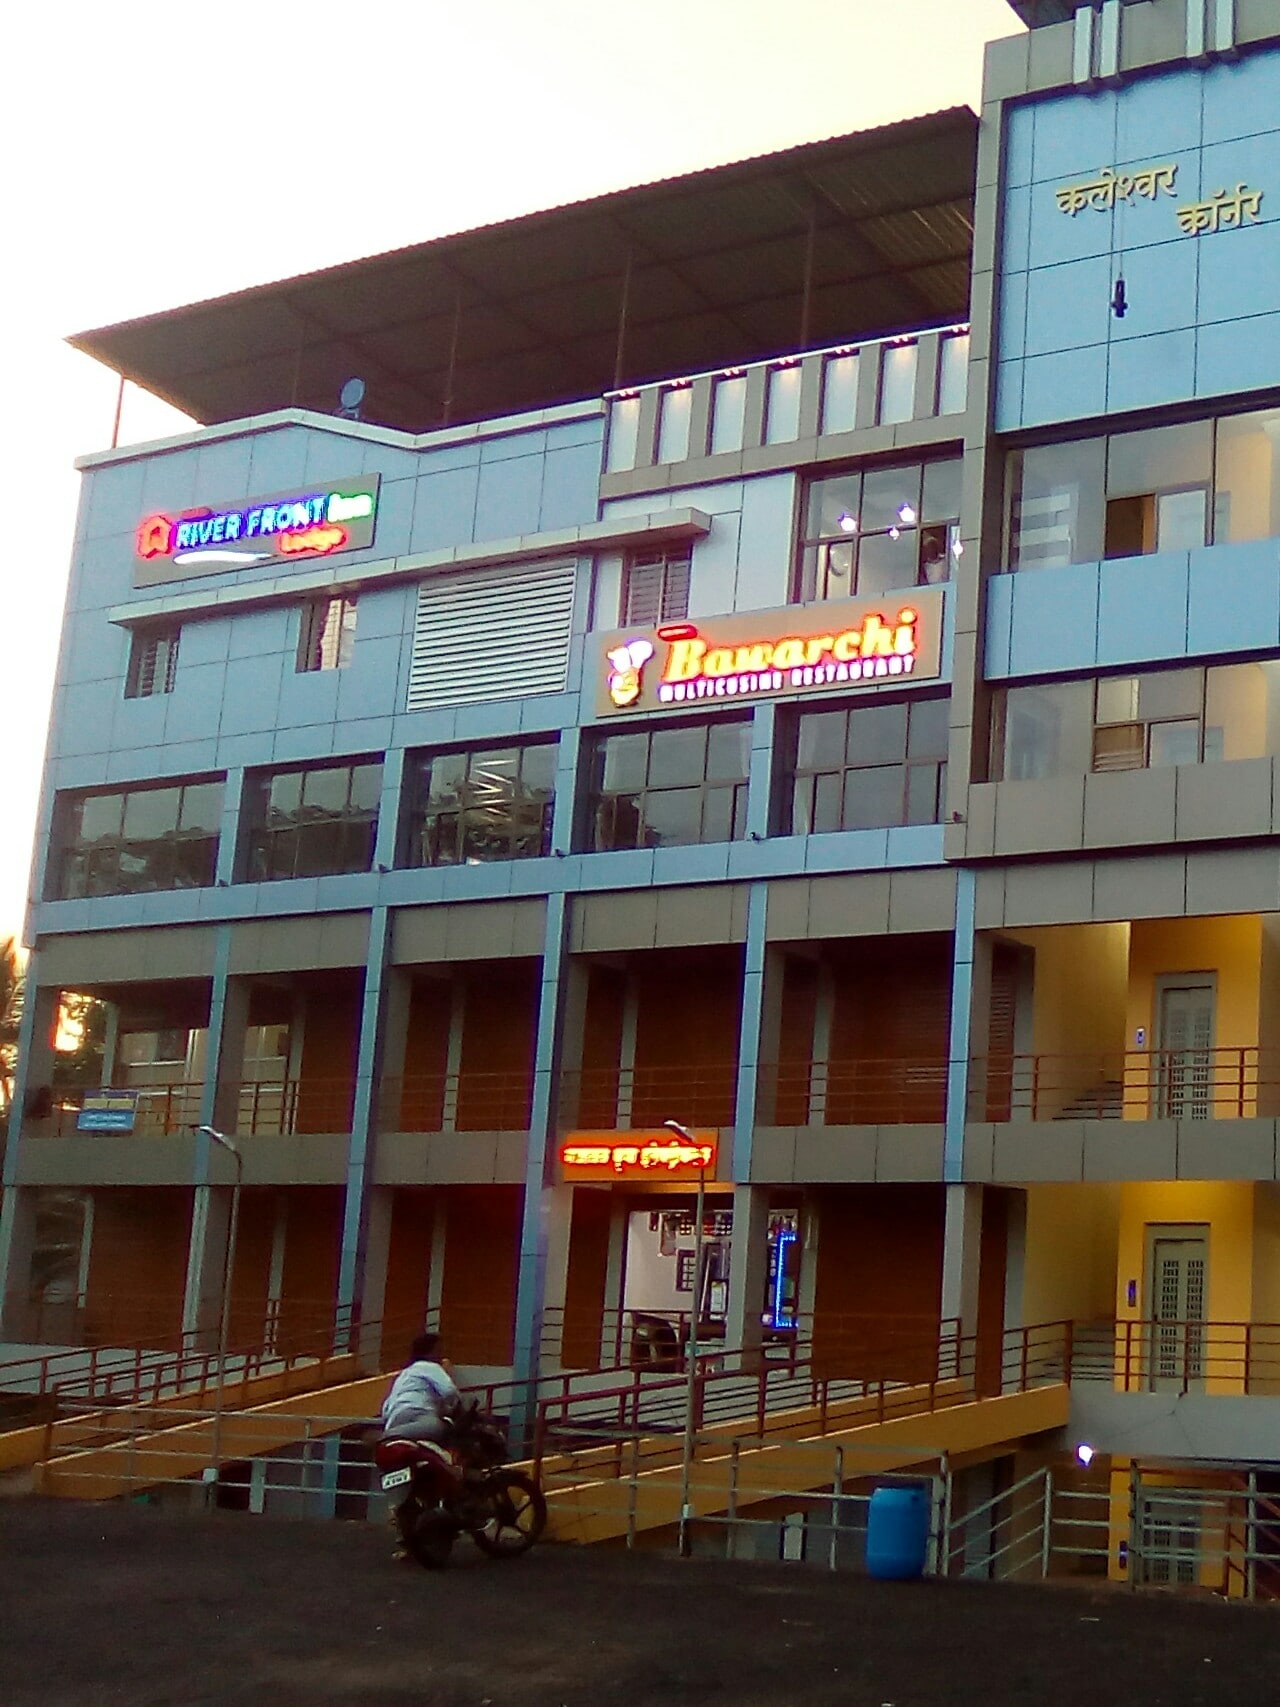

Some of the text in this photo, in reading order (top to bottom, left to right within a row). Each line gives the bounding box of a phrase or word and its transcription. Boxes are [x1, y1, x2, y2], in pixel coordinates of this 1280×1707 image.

[1176, 181, 1265, 237] कॉर्नर
[175, 512, 243, 549] RIVER
[247, 495, 327, 536] FRONT
[662, 607, 918, 684] Bawarchi
[791, 653, 915, 688] RESTAURANT
